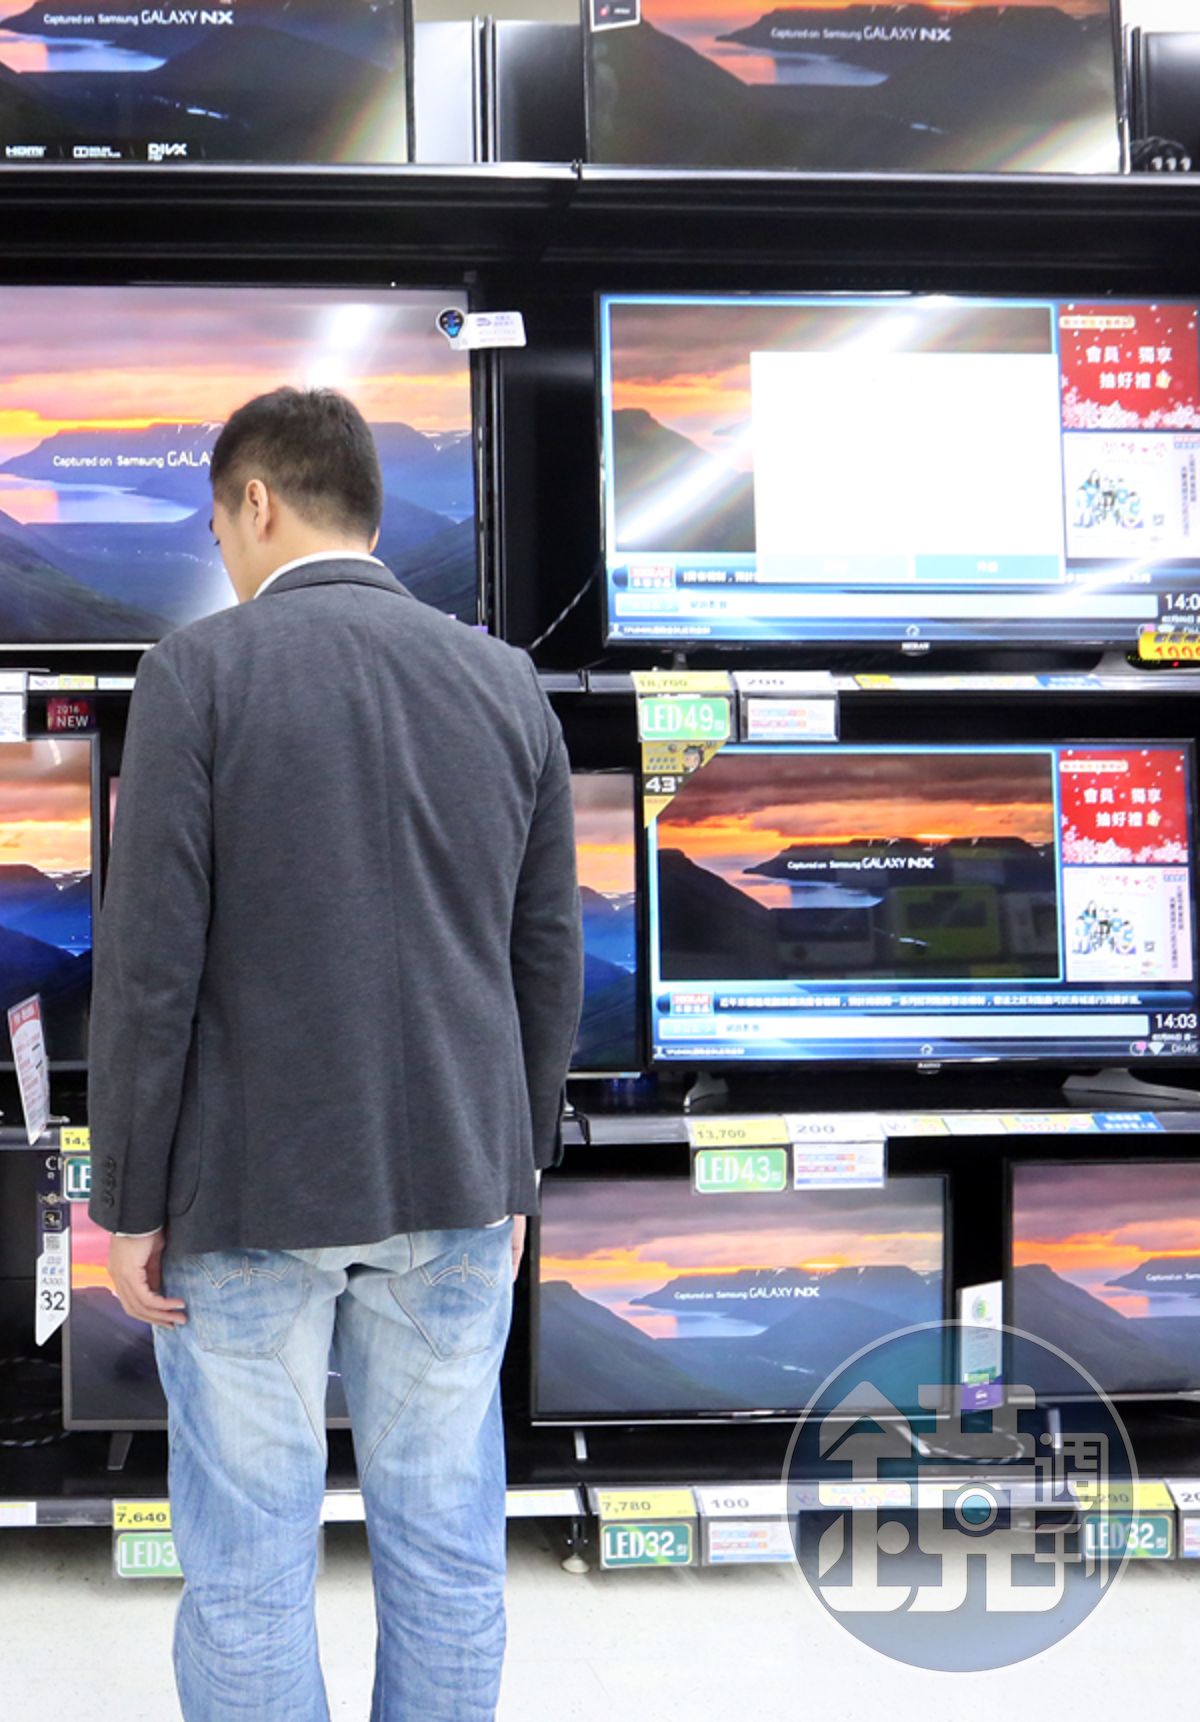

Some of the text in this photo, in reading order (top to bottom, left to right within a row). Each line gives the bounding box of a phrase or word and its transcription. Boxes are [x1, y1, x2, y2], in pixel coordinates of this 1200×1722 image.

[44, 14, 82, 25] Captured
[98, 14, 138, 26] Samsung
[142, 10, 198, 25] GALAXY
[201, 11, 234, 24] NX
[770, 28, 808, 38] Captured
[823, 28, 862, 40] Samsung
[864, 26, 917, 40] GALAXY
[920, 28, 951, 41] NX
[5, 146, 47, 158] HDMI
[53, 451, 212, 468] Captured on Samsung GALA
[57, 705, 80, 714] 2016
[56, 716, 89, 728] NEW
[642, 704, 714, 732] LED49
[862, 856, 907, 870] GALAXY
[908, 858, 935, 869] NX
[1156, 1014, 1198, 1028] 14:03
[797, 1124, 835, 1134] 200
[700, 1156, 770, 1184] LED43
[750, 1287, 792, 1298] GALAXY
[794, 1286, 820, 1298] NX
[40, 1291, 66, 1310] 32
[602, 1501, 652, 1512] 7,780
[710, 1498, 750, 1509] 100
[116, 1512, 168, 1524] 7,640
[1086, 1522, 1154, 1550] LED32
[606, 1530, 675, 1558] LED32
